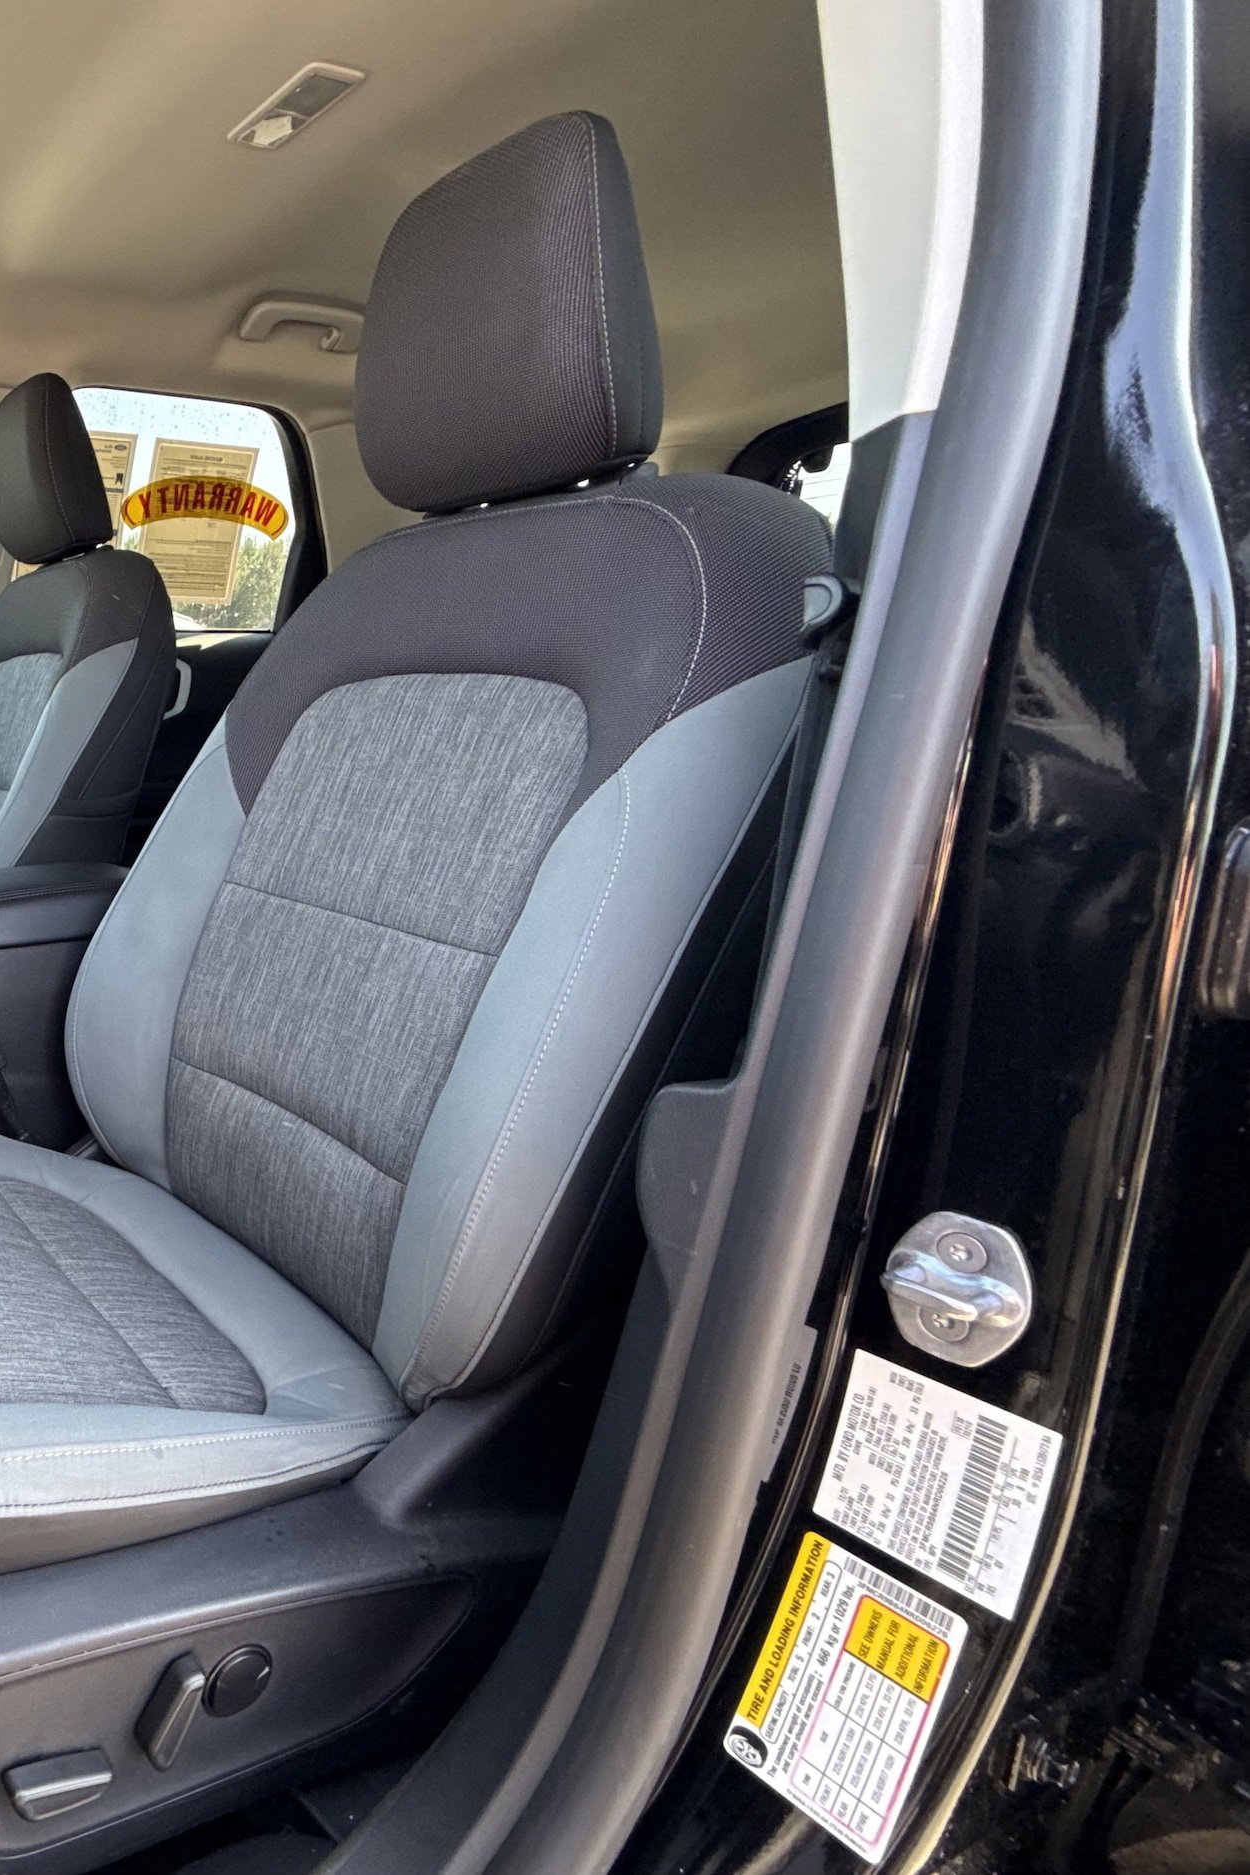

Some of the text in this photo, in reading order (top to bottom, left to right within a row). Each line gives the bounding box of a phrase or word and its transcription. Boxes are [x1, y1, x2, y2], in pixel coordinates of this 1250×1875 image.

[839, 1428, 855, 1452] FORD
[845, 1403, 861, 1431] MOTOR
[836, 1448, 849, 1462] BY
[746, 1539, 825, 1722] TIRE AND LOADING INFORMATION
[815, 1580, 855, 1667] 466 kg or 1029 lbs.
[856, 1608, 883, 1659] SEE OWNERS
[874, 1618, 901, 1671] MANUAL FOR
[892, 1631, 919, 1680] ADDITIONAL
[911, 1638, 940, 1694] INFORMATION
